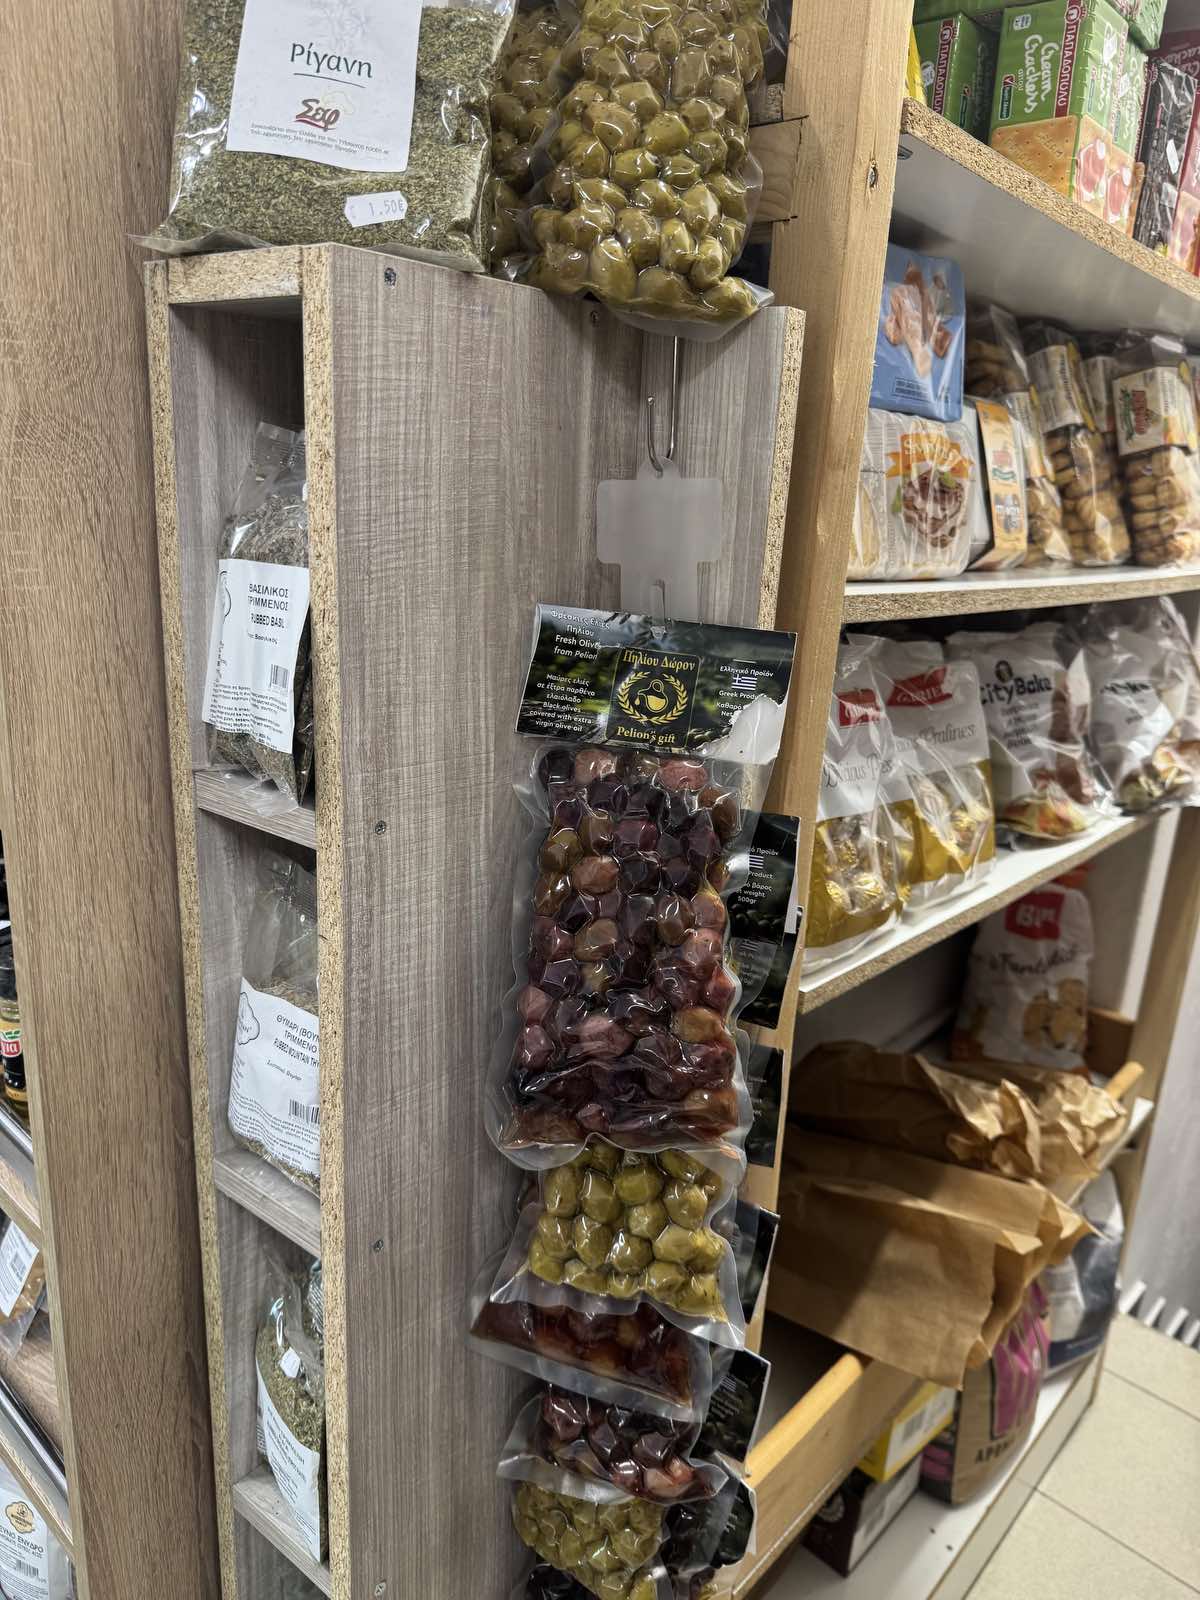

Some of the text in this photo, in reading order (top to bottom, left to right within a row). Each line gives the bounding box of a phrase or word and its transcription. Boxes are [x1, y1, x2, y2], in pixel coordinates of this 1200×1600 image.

[290, 42, 373, 78] Ρίγανη
[1024, 34, 1042, 113] Crackers
[1041, 43, 1059, 102] Cream
[567, 624, 595, 637] Πηλίου
[555, 634, 601, 650] Fresh Olive
[554, 646, 598, 660] from Pelion
[623, 649, 696, 673] Πηλίου Δώρον
[720, 666, 749, 675] Ελληνικό
[546, 673, 571, 685] Μαύρες
[566, 686, 596, 697] παρθένο
[719, 690, 739, 698] Greek
[546, 693, 582, 704] ελαιόλαδο
[543, 701, 581, 713] Black olives
[716, 702, 742, 711] Καθαρό
[529, 710, 556, 718] covered
[557, 713, 573, 722] with
[535, 720, 553, 729] virgin
[573, 723, 583, 732] oil
[657, 734, 676, 745] gift
[744, 889, 766, 898] weight
[737, 896, 757, 904] 500gr
